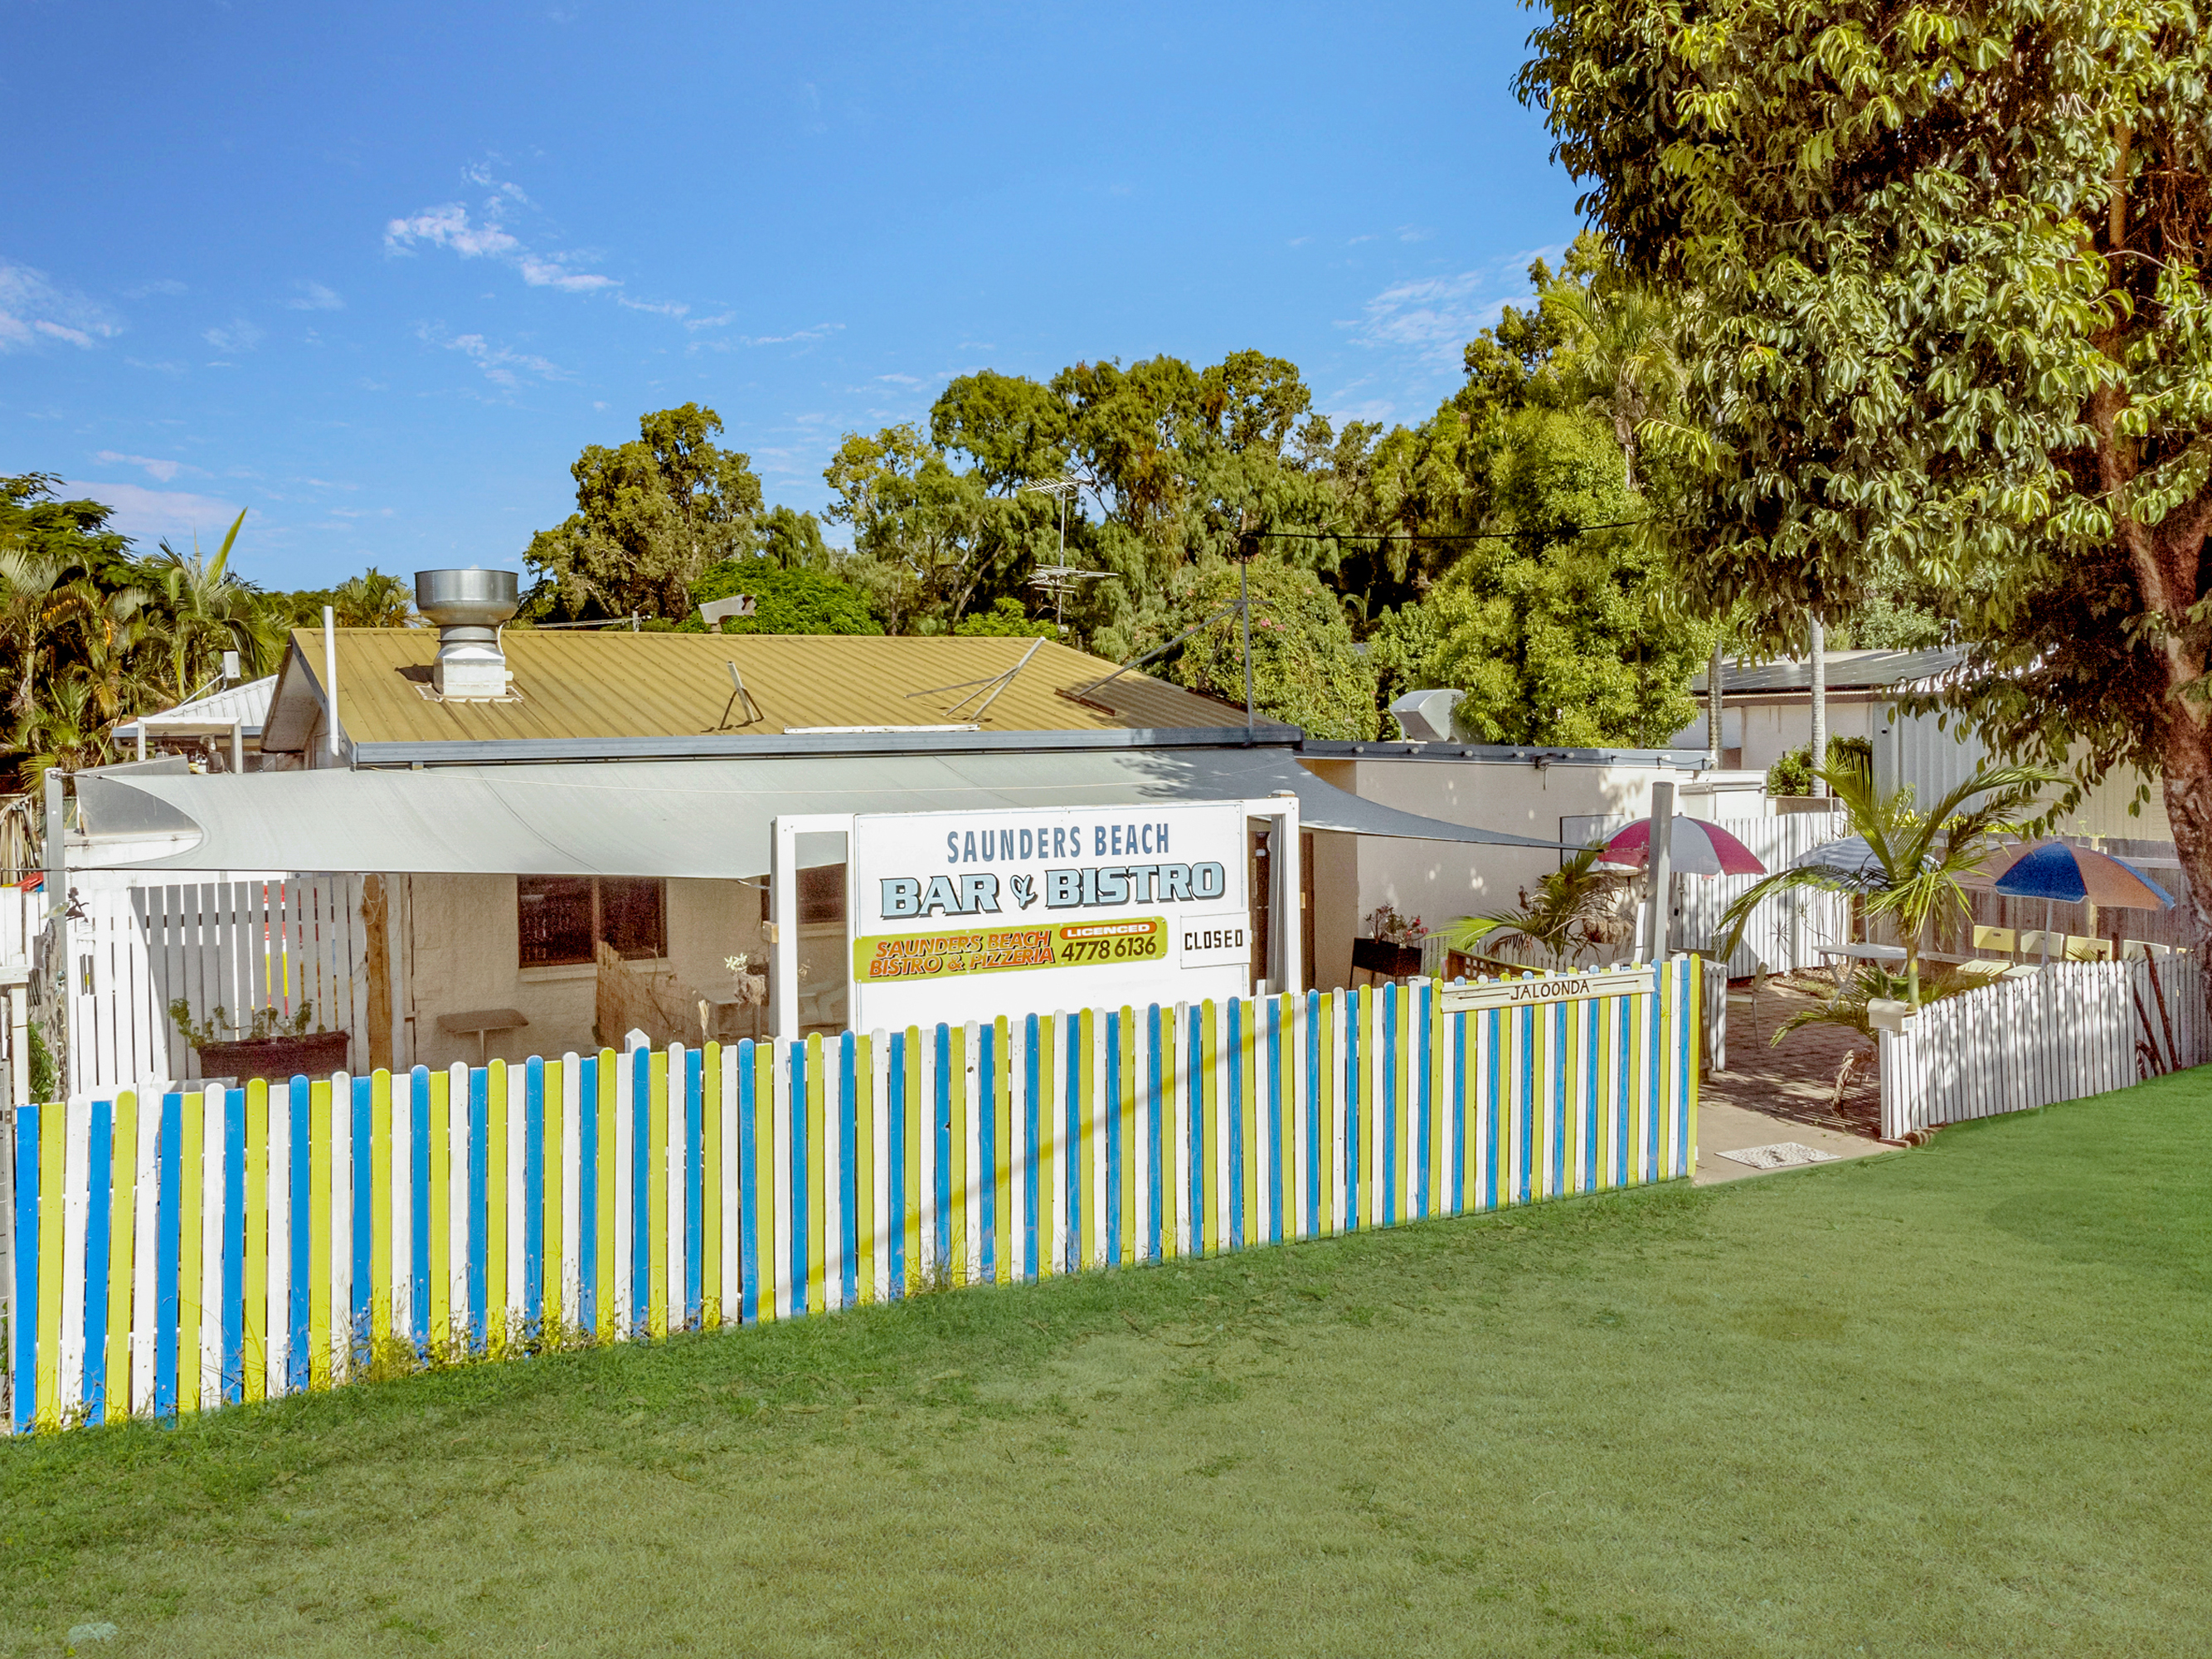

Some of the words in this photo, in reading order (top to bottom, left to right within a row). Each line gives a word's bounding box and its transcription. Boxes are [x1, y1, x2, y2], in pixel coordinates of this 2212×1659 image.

[947, 826, 1081, 864] SAUNDERS
[1095, 823, 1169, 857] BEACH
[879, 873, 1003, 920] BAR
[1009, 874, 1038, 910] &
[1044, 861, 1226, 909] BISTRO
[876, 935, 984, 958] SAUNDERS
[987, 930, 1053, 949] BEACH
[1067, 925, 1151, 937] LICENCED
[1184, 929, 1244, 951] CLOSED
[1062, 941, 1111, 961] 4778
[1115, 936, 1157, 957] 6136
[868, 956, 942, 977] BISTRO
[946, 955, 965, 971] &
[969, 947, 1055, 969] PIZZERIA
[1510, 980, 1590, 1000] JALOONDA
